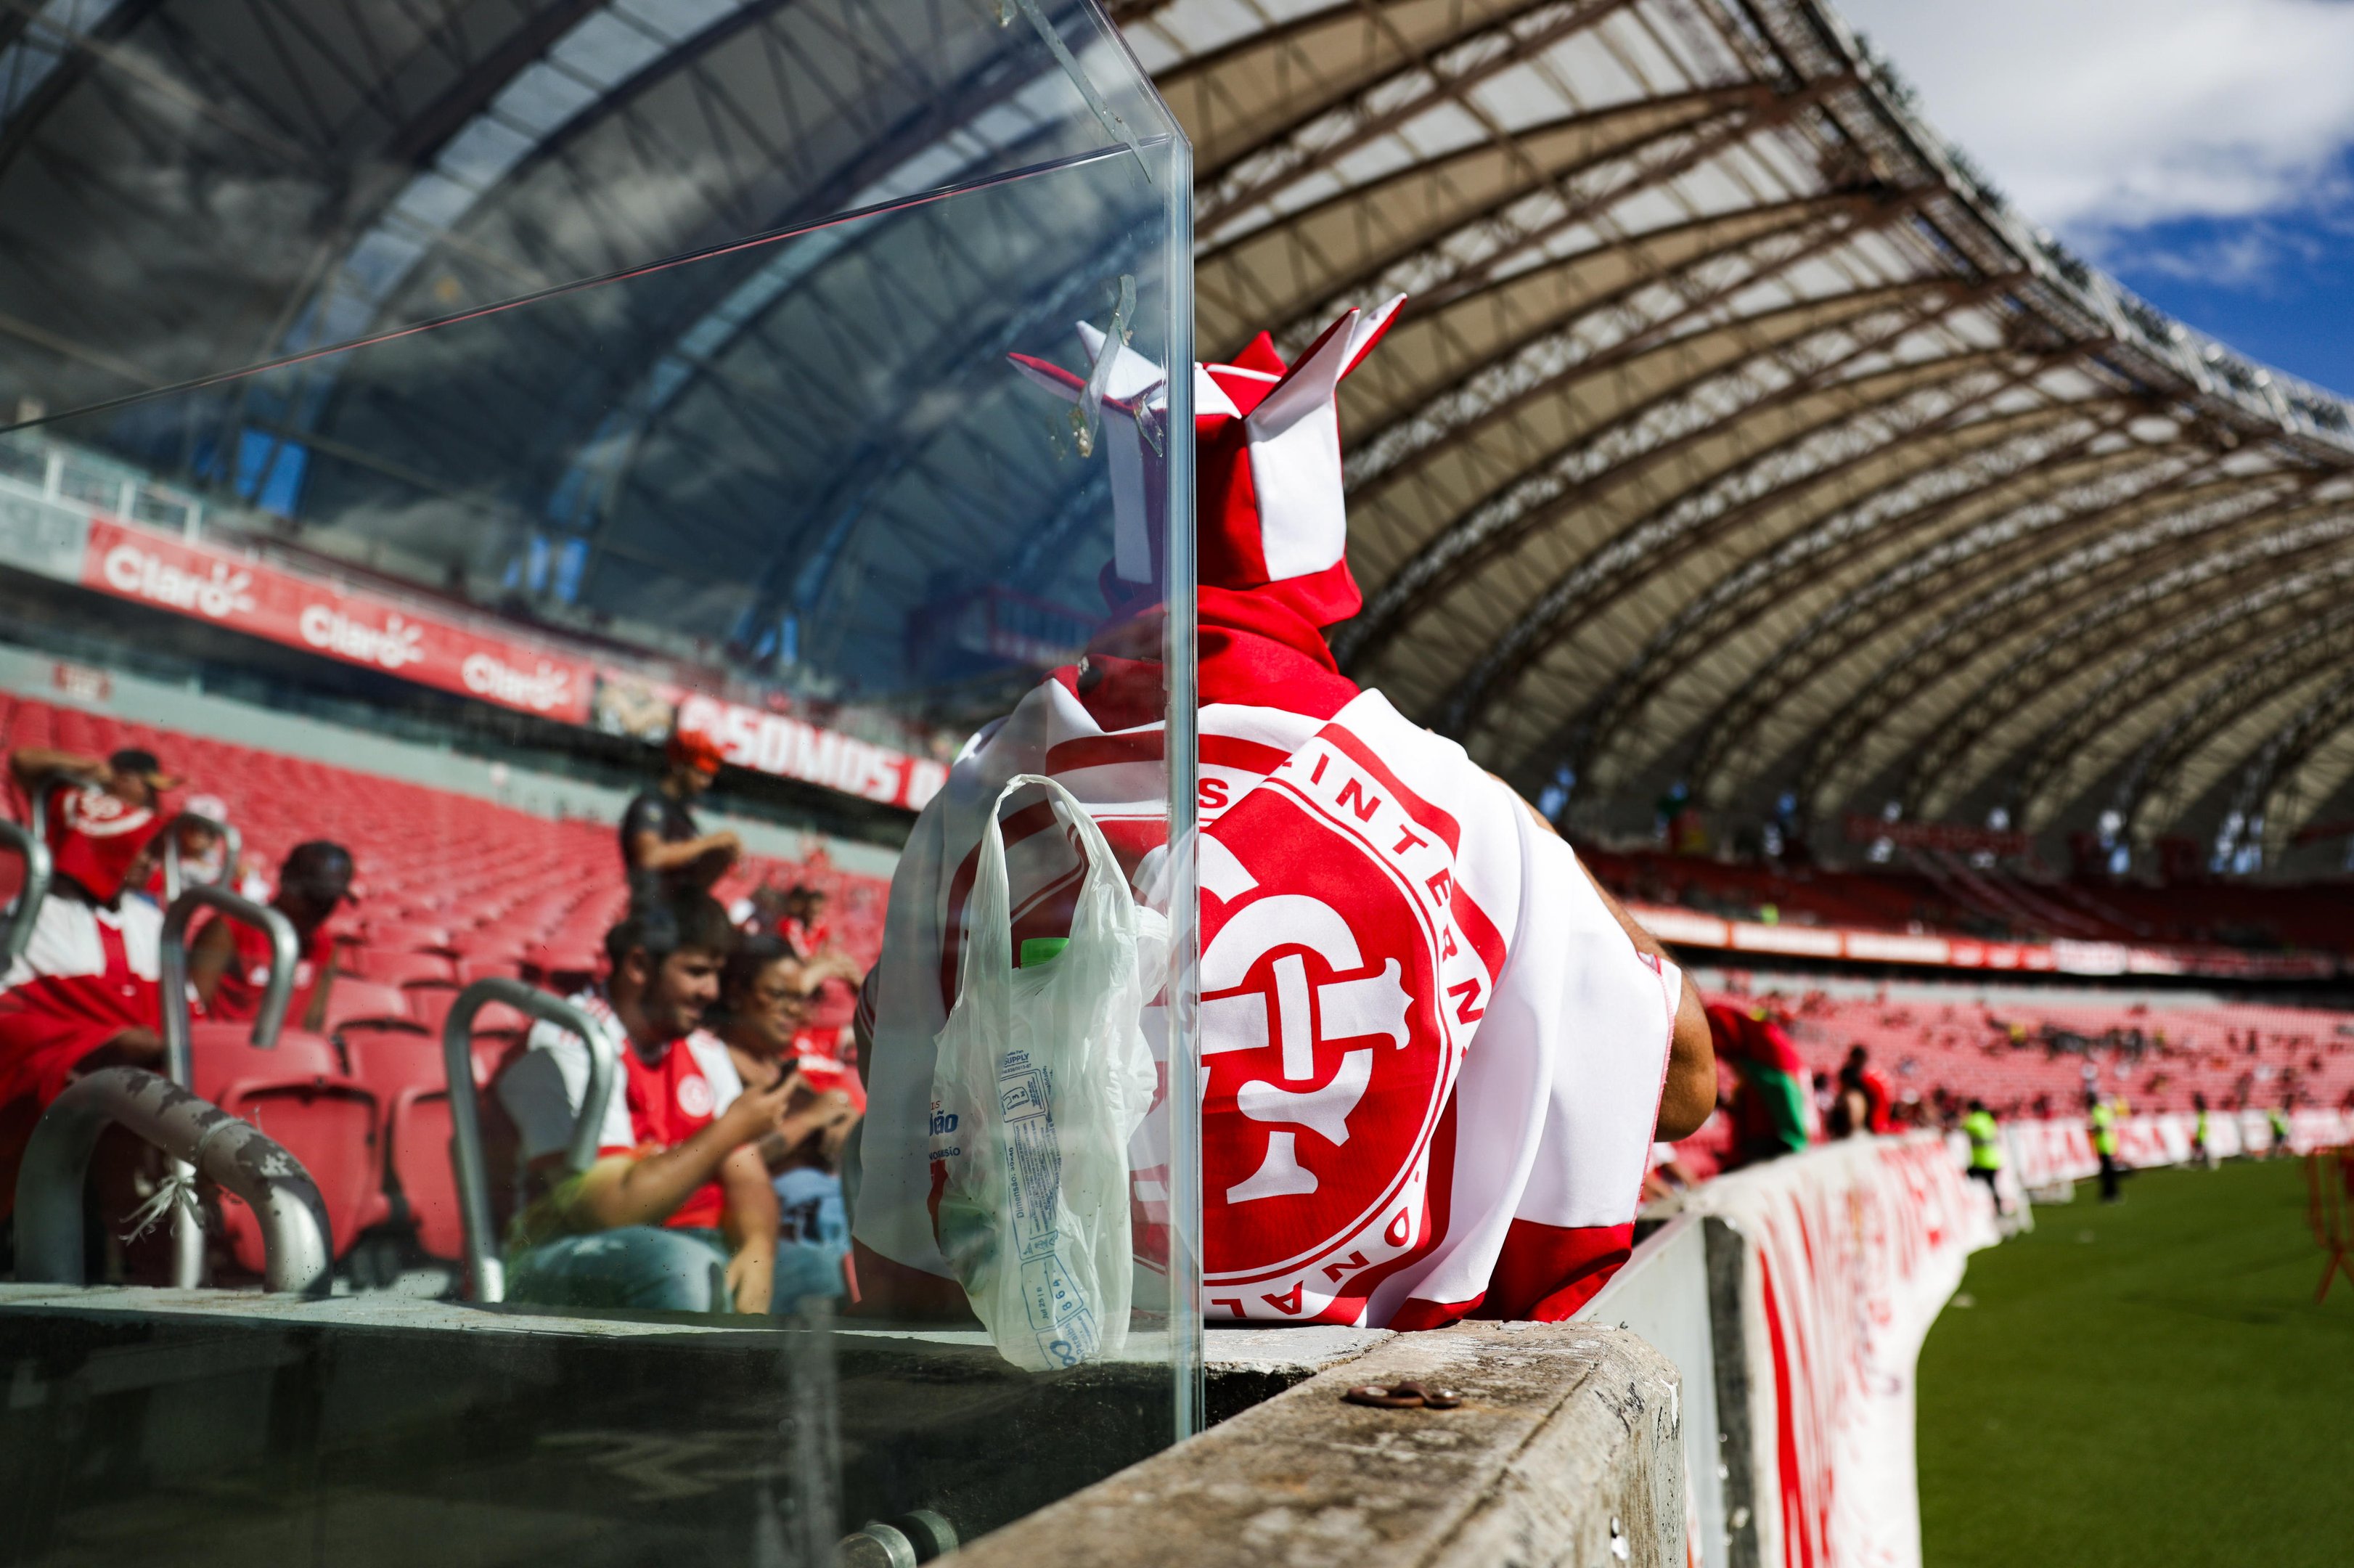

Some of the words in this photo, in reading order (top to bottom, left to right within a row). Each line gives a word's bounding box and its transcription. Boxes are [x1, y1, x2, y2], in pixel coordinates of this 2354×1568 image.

[103, 544, 235, 617] Claro
[300, 604, 408, 669] Claro
[461, 652, 553, 710] Claro
